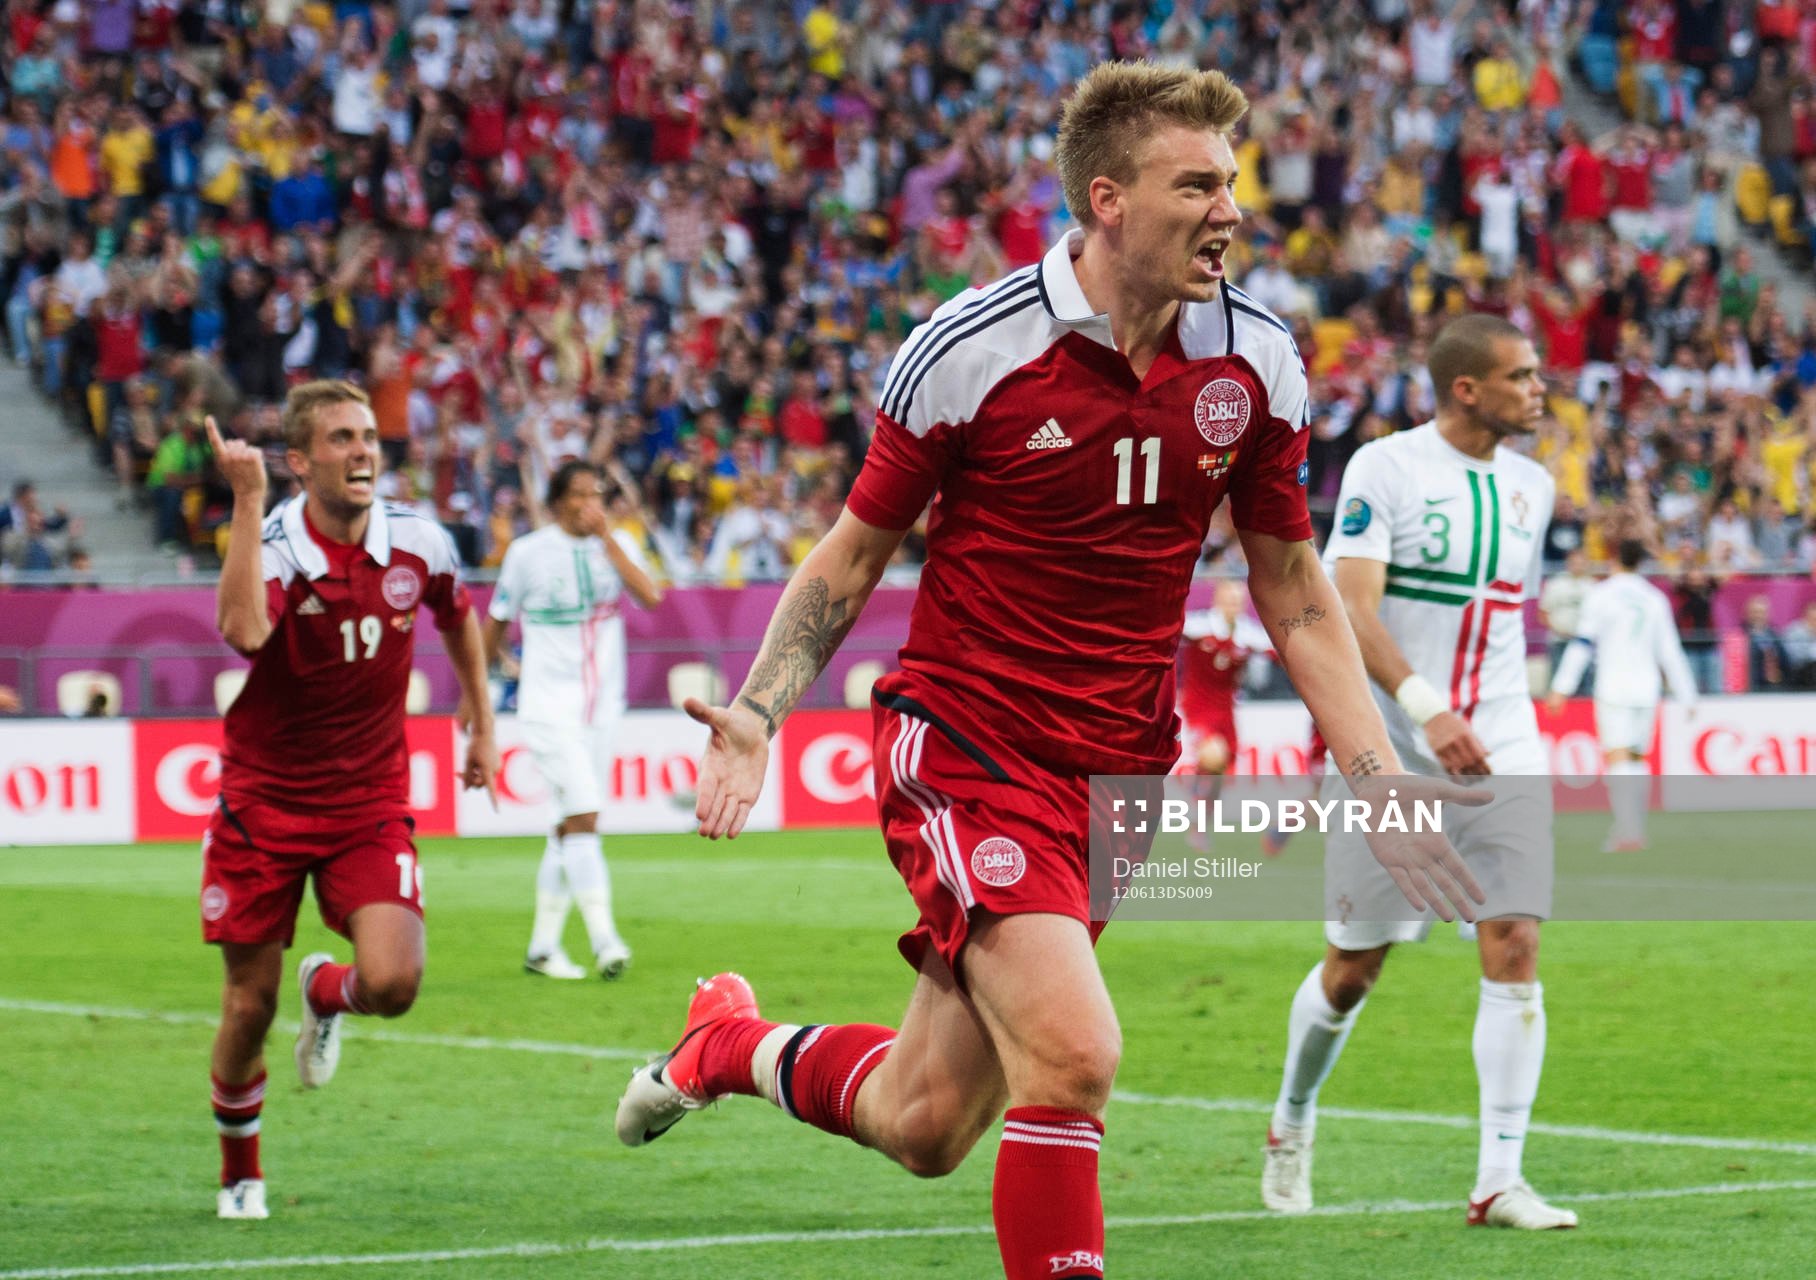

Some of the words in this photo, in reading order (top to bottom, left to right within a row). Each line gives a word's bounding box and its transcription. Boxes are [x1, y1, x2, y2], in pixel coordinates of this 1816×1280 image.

[1208, 401, 1239, 421] DBU
[1026, 437, 1073, 450] adidas
[1213, 432, 1235, 443] 1889
[1113, 437, 1161, 505] 11
[1420, 512, 1451, 564] 3
[339, 614, 383, 662] 19
